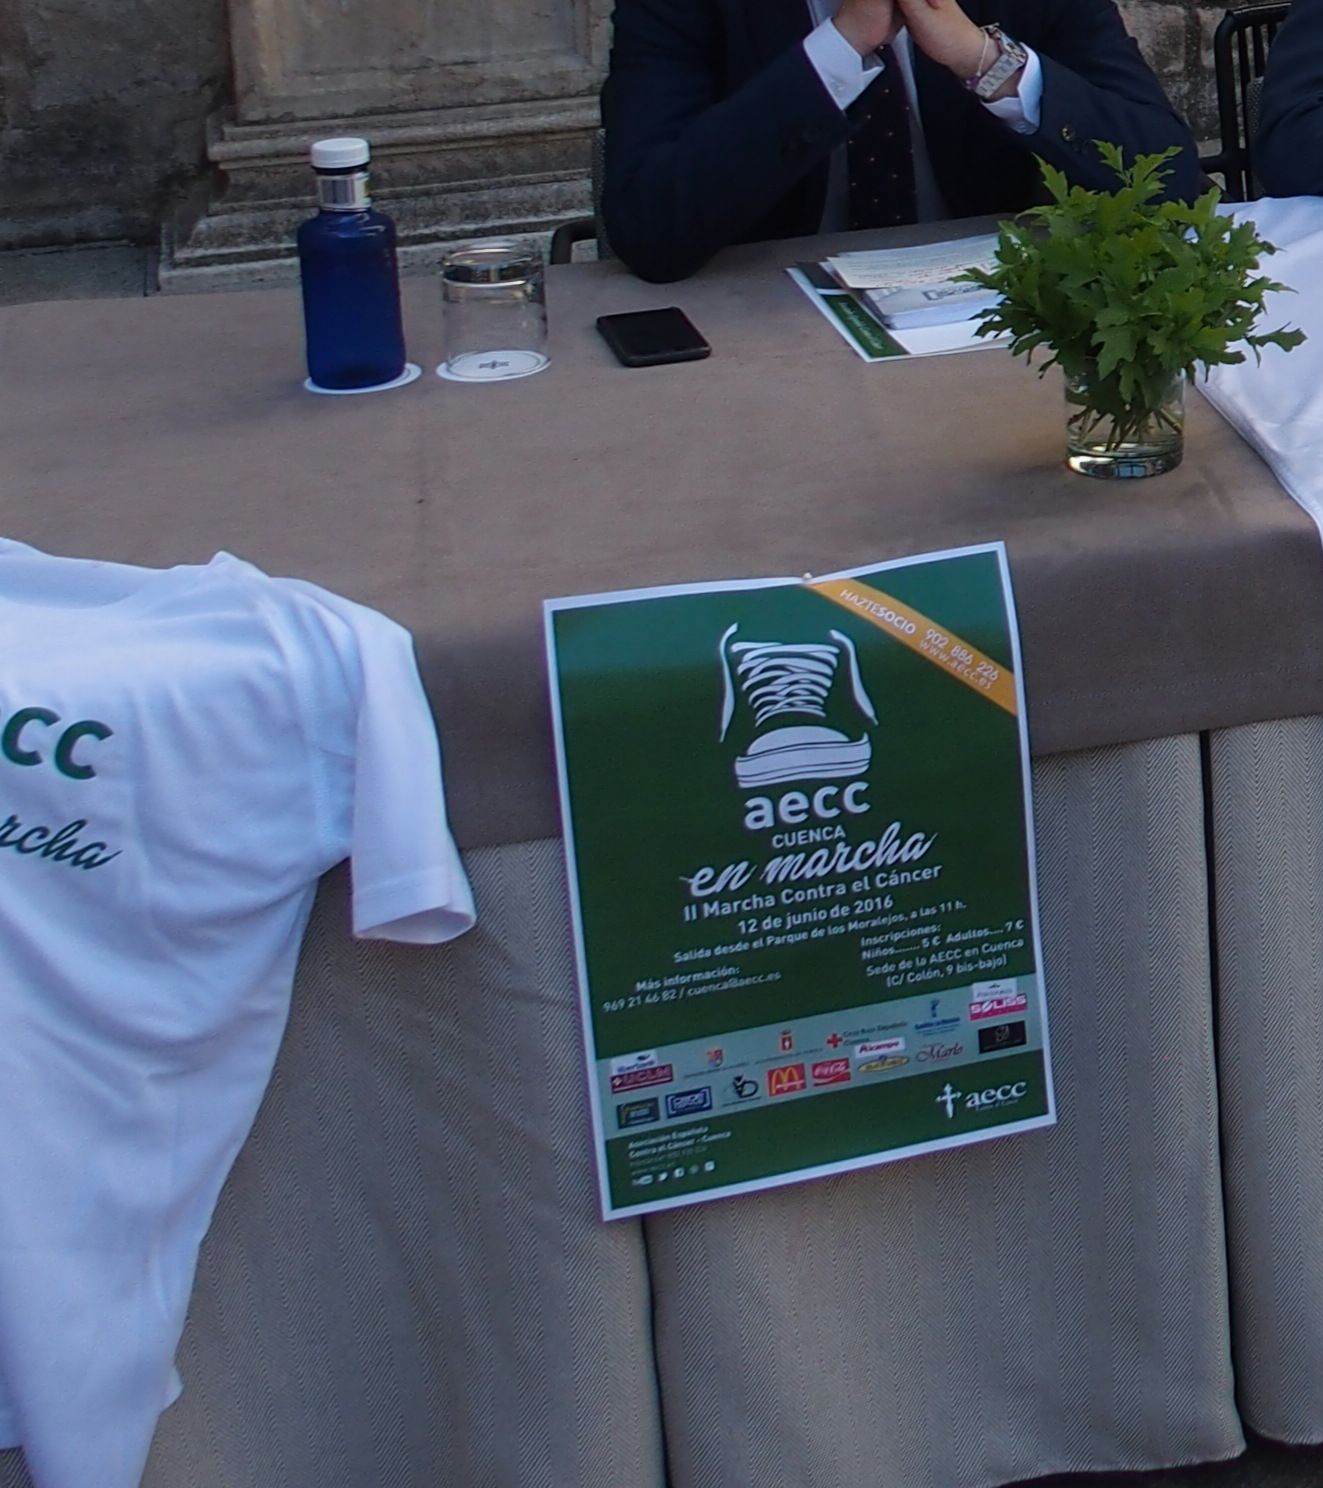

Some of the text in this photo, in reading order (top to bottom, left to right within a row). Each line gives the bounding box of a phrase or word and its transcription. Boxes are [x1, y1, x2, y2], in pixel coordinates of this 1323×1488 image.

[926, 628, 949, 650] 902
[951, 642, 974, 666] 886
[975, 658, 999, 681] 226
[743, 781, 872, 830] aecc
[772, 824, 846, 849] CUENCA
[679, 821, 938, 898] en marcha
[683, 865, 943, 922] II Marcha Contra el Cáncer
[673, 948, 712, 963] Salida
[713, 942, 749, 957] desde
[752, 939, 765, 949] el
[766, 932, 809, 948] Parque
[811, 927, 826, 939] de
[827, 924, 846, 936] los
[920, 905, 937, 916] las
[737, 894, 894, 935] 12 de junio de 2016
[860, 923, 942, 947] Inscripciones:
[664, 965, 740, 987] información:
[866, 937, 1025, 977] Sede de la AECC en Cuenca
[965, 1081, 1027, 1109] aecc
